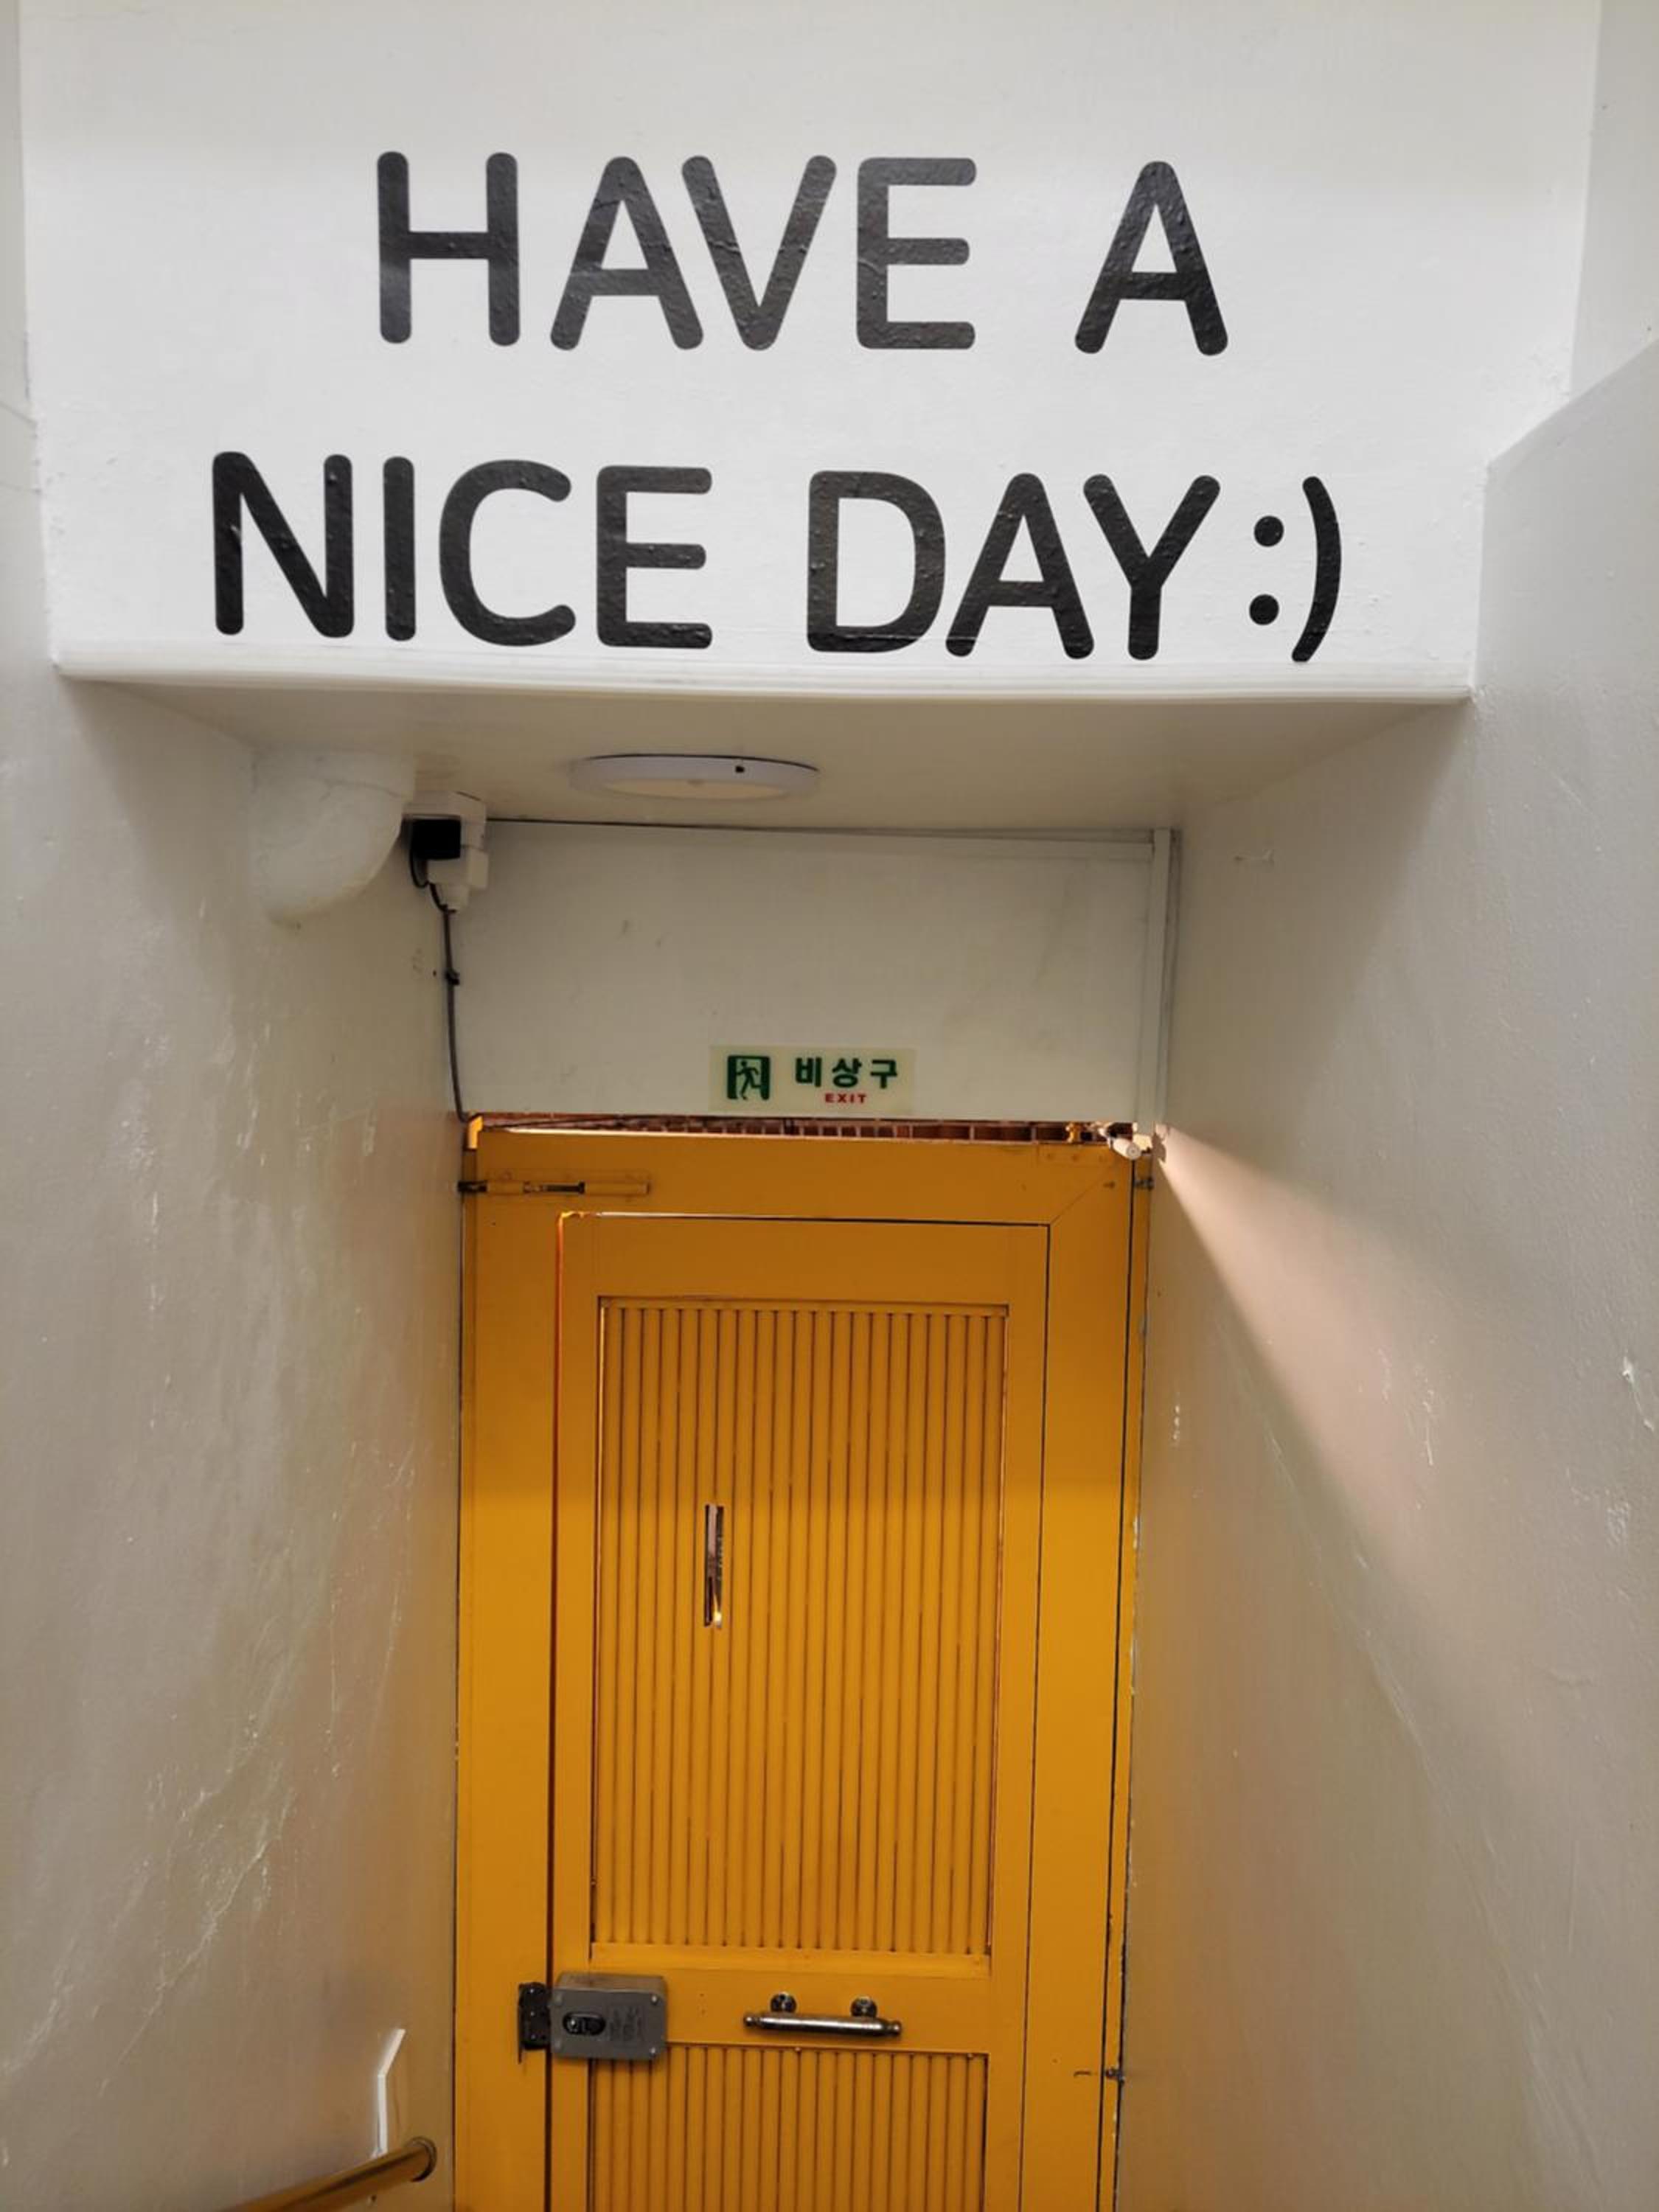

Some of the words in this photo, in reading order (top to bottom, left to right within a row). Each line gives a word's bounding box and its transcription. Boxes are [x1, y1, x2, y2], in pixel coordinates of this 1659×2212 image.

[376, 151, 976, 351] HAVE
[1074, 161, 1229, 355] A
[212, 451, 713, 650] NICE
[795, 1057, 898, 1088] 비상구
[824, 1093, 867, 1104] EXIT
